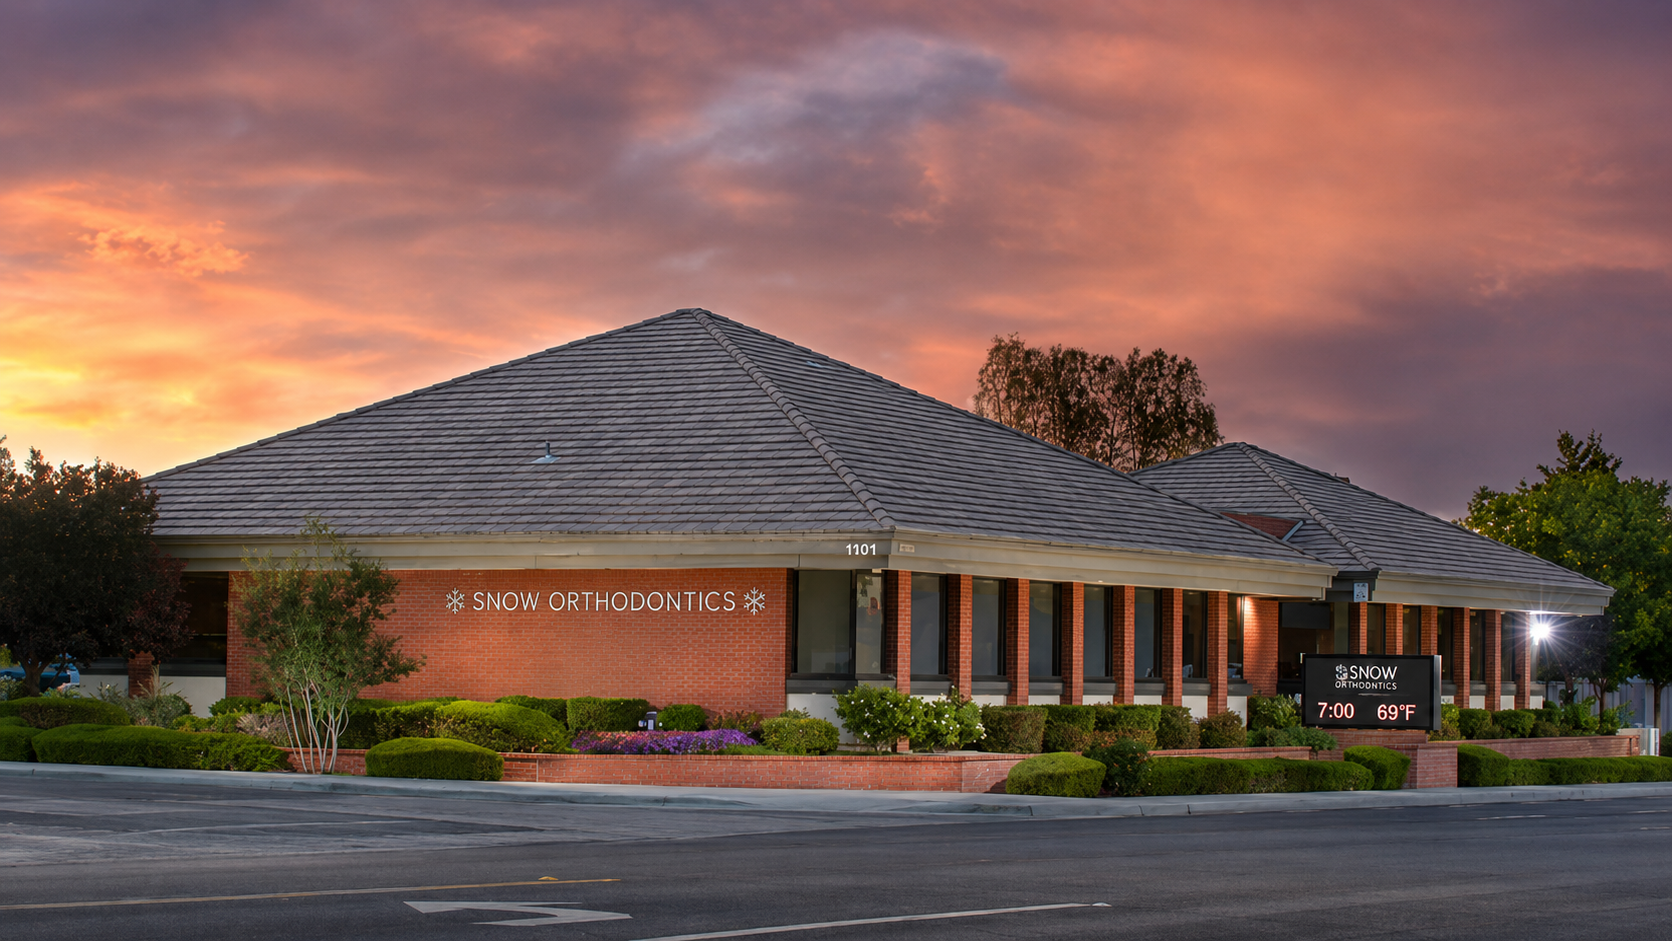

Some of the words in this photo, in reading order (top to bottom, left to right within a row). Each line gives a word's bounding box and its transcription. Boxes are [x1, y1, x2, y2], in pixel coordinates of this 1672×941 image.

[846, 543, 876, 555] 1101
[472, 591, 540, 611] SNOW
[549, 591, 736, 611] ORTHODONTICS
[1350, 665, 1398, 680] SNOW
[1317, 702, 1355, 719] 7:00
[1377, 704, 1416, 720] 69°F
